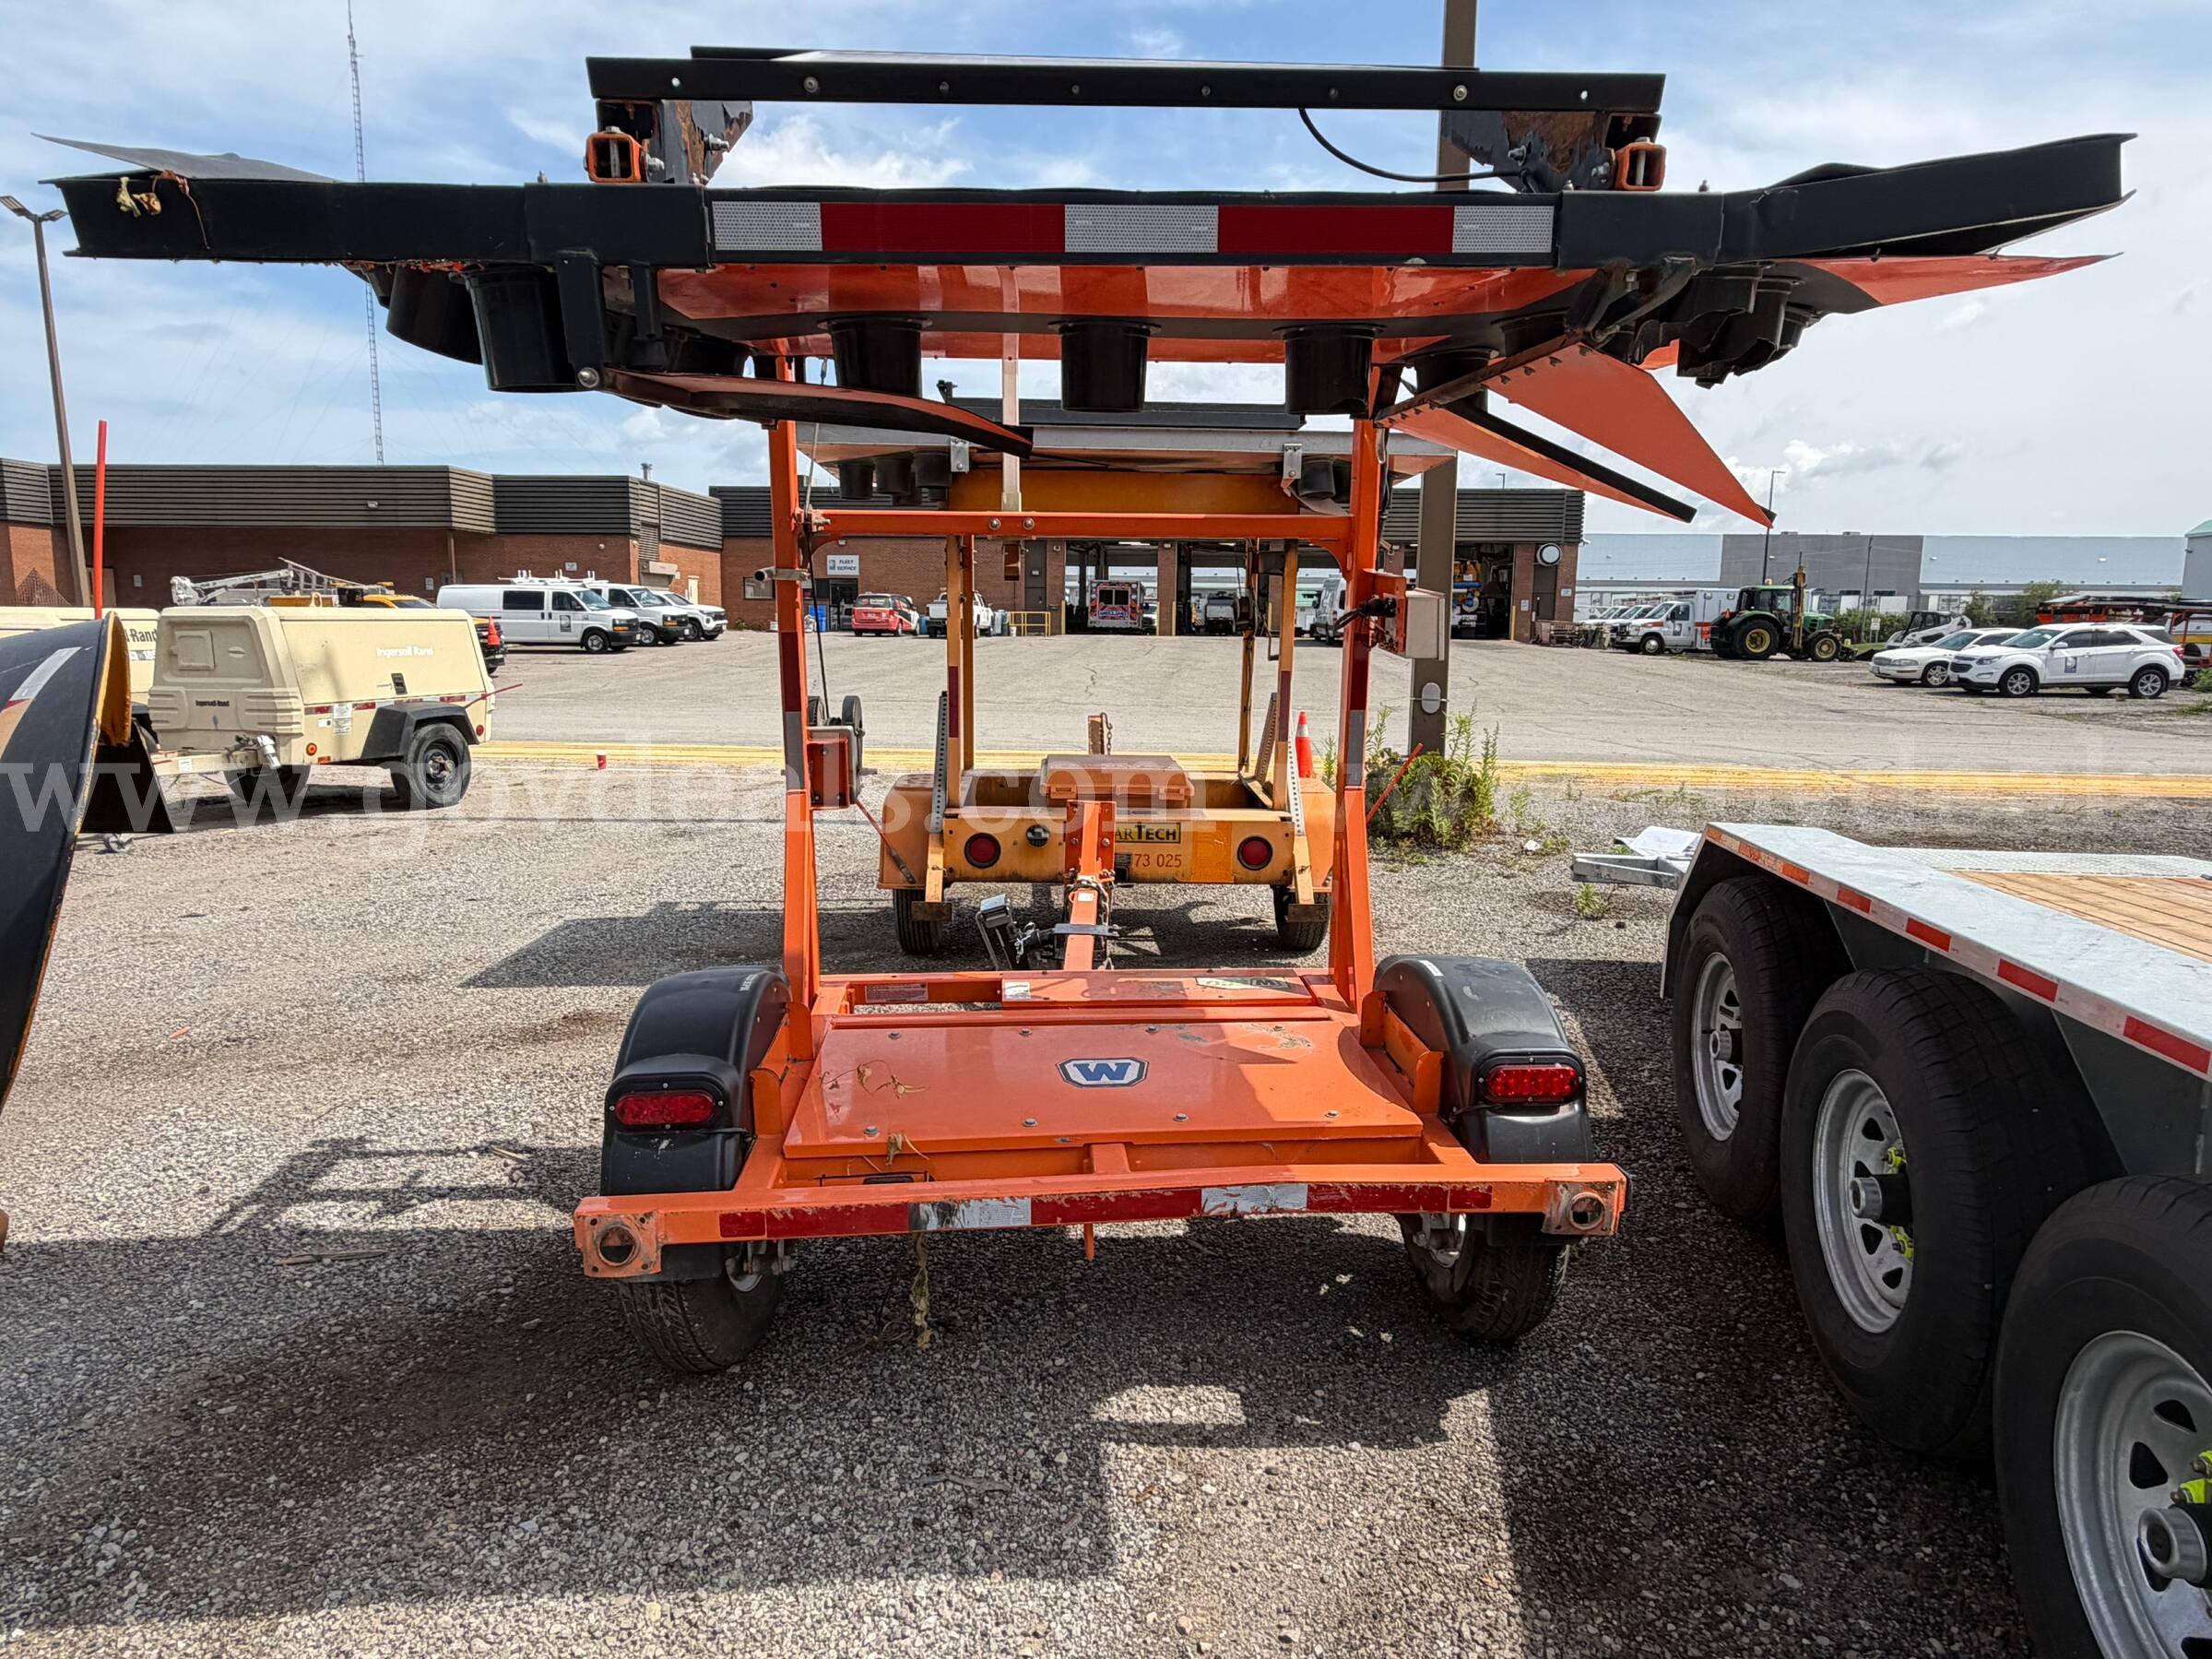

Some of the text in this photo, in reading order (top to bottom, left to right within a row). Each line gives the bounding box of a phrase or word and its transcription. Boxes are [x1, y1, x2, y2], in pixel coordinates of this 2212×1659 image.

[376, 646, 433, 658] Ingersoll Rand
[1134, 853, 1182, 868] 73 025
[1072, 1061, 1131, 1082] W
